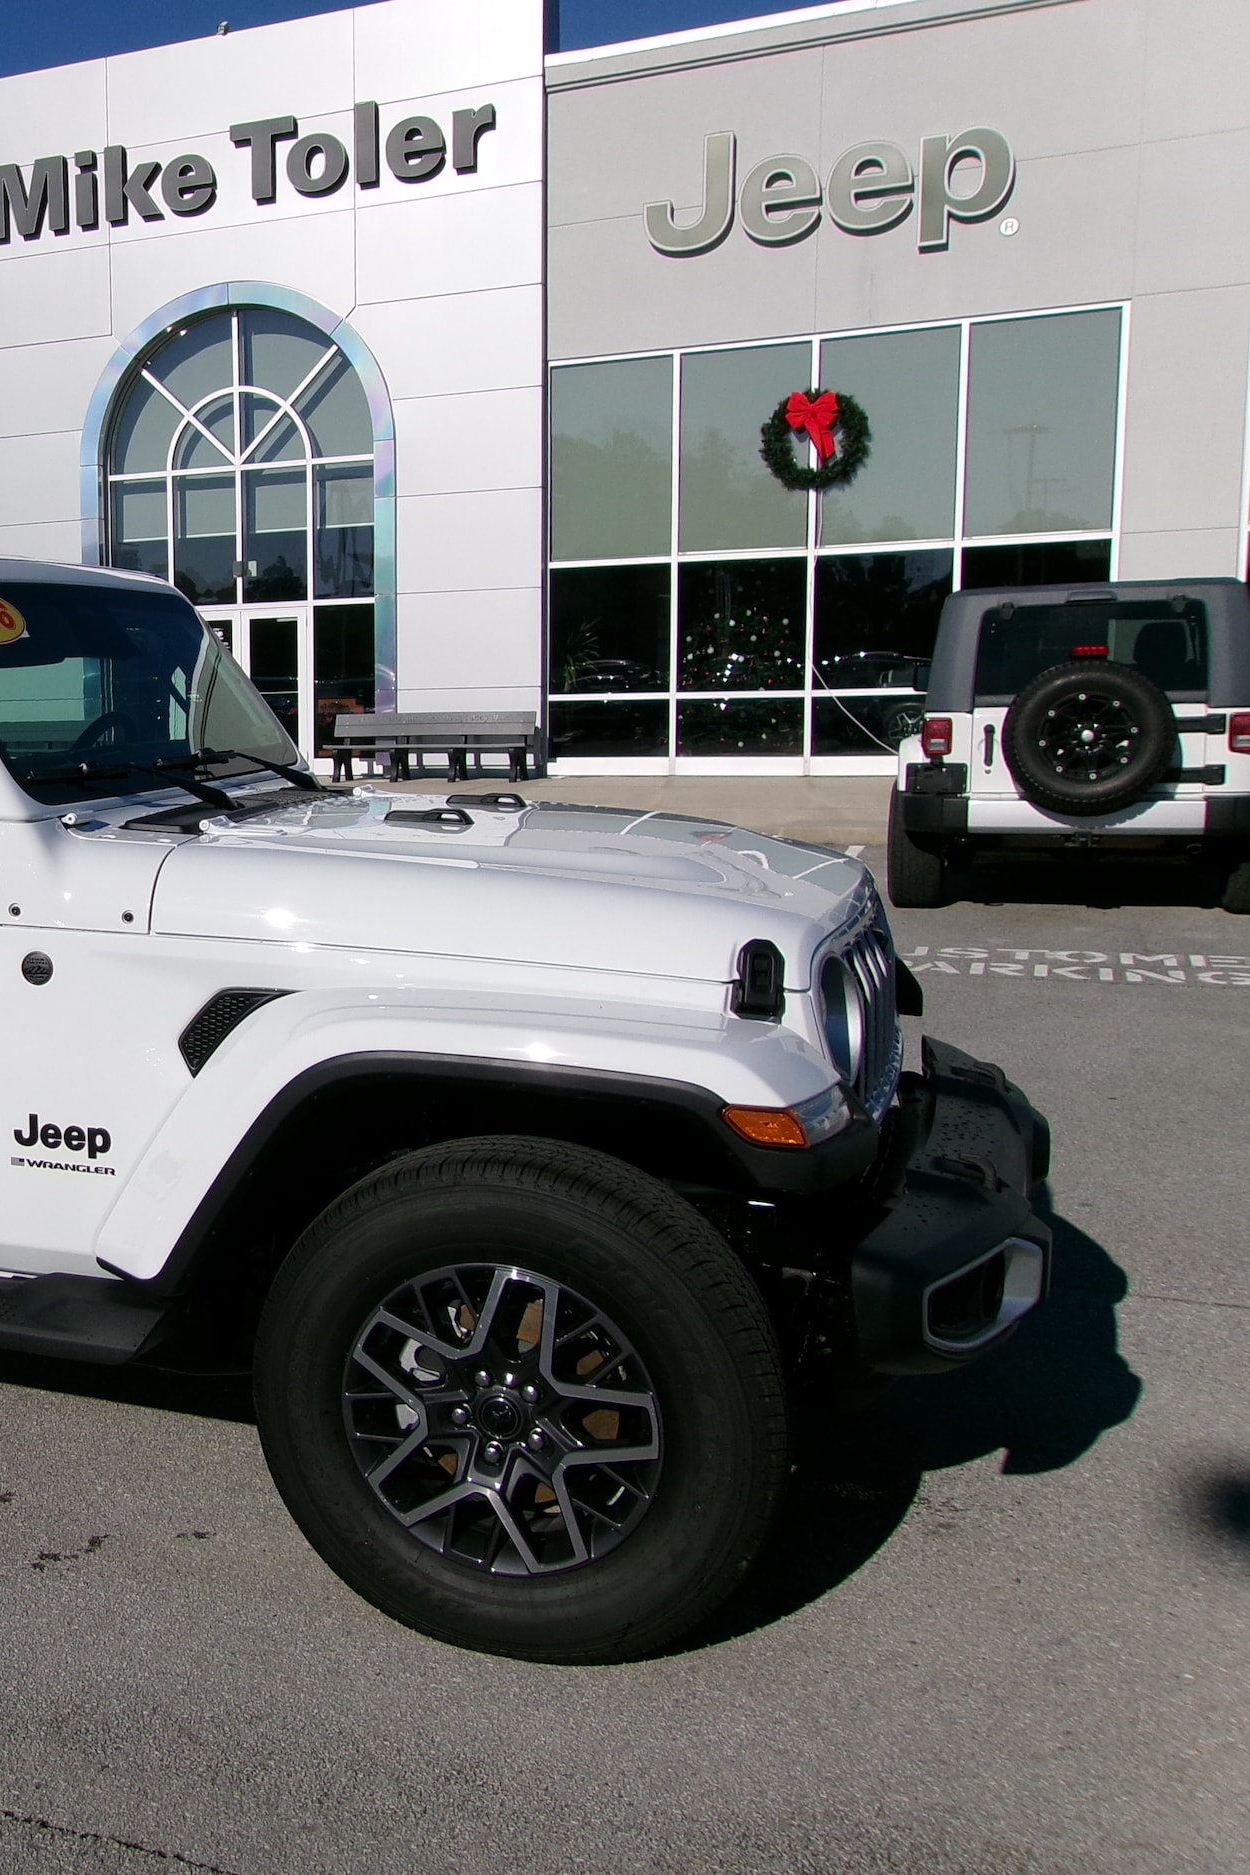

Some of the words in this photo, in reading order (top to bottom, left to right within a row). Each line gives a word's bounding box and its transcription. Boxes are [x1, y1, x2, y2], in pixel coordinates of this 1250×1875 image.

[230, 100, 496, 205] Toler
[643, 126, 1016, 258] Jeep
[902, 959, 1250, 985] ARKING
[13, 1113, 112, 1159] Jeep
[26, 1158, 117, 1176] WRANGLER
